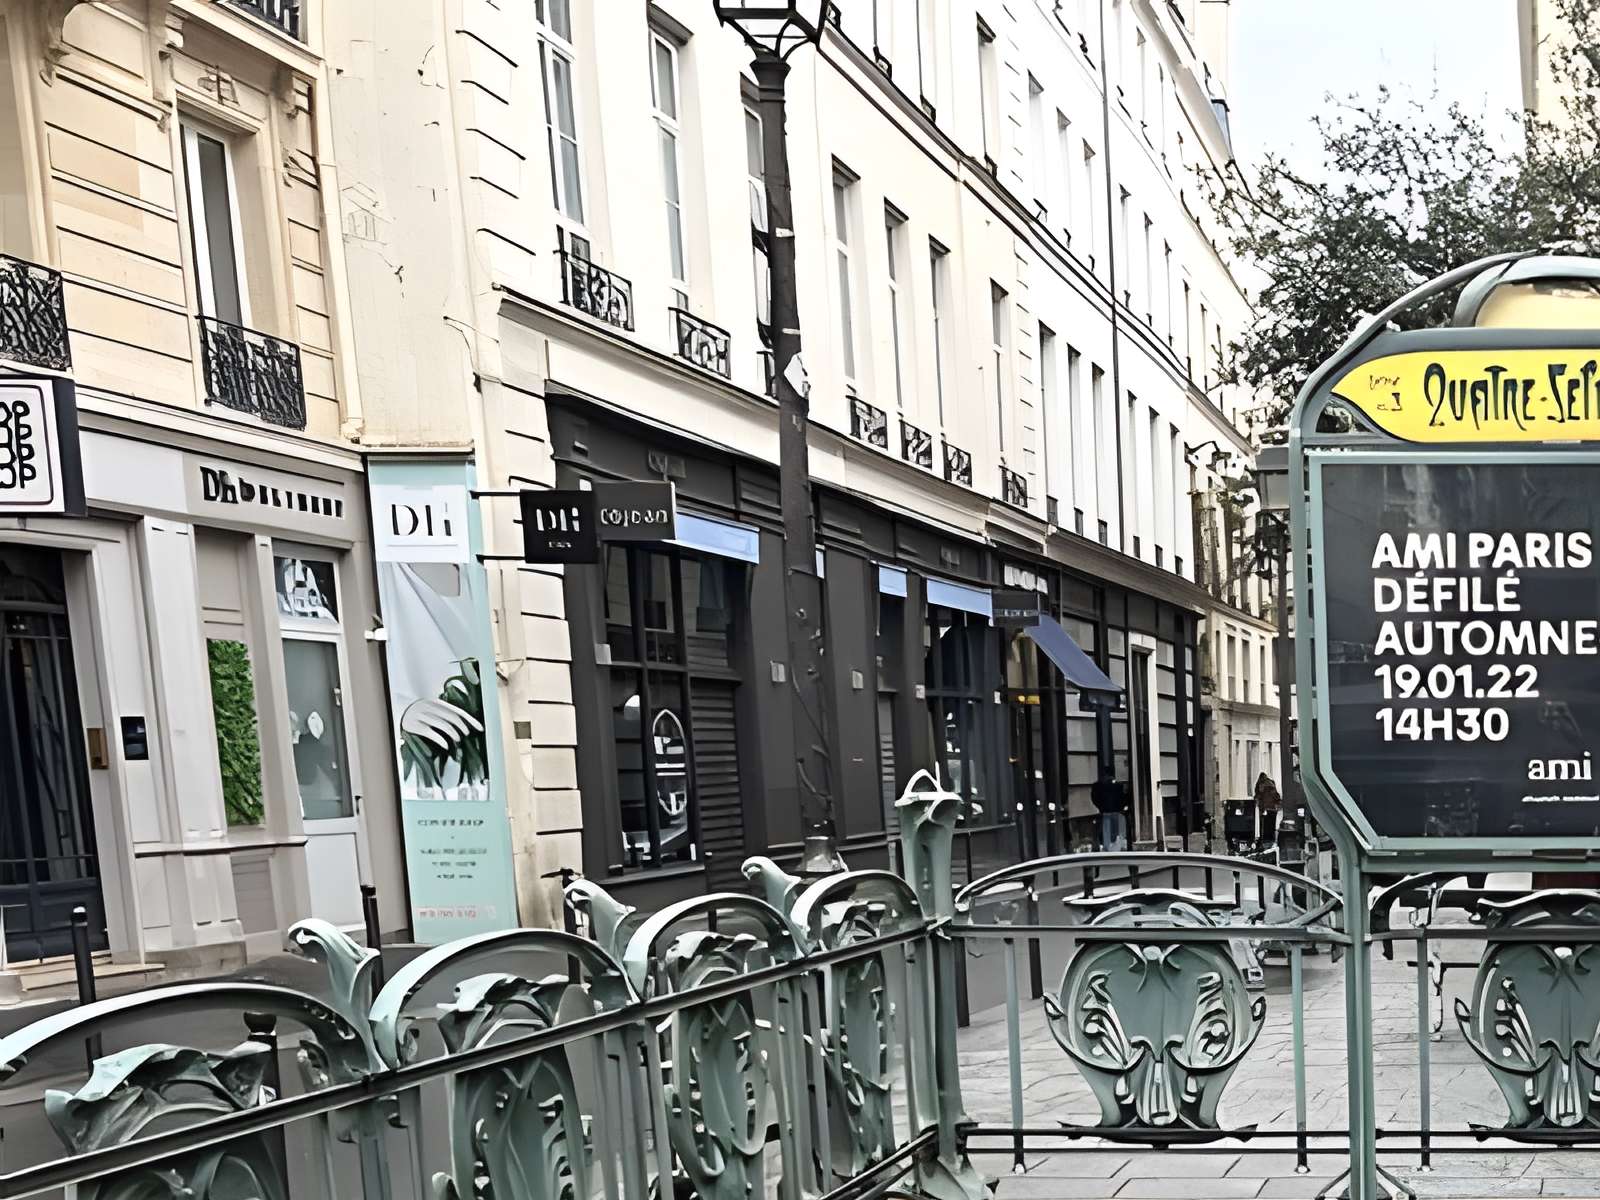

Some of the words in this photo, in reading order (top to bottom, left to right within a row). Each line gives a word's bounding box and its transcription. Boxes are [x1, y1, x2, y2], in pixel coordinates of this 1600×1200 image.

[1371, 532, 1457, 569] AMI
[1468, 531, 1593, 569] PARIS
[1374, 570, 1521, 613] DÉFILÉ
[1374, 663, 1540, 699] 19.01.22
[1375, 707, 1510, 742] 14H30
[1527, 750, 1593, 780] ami
